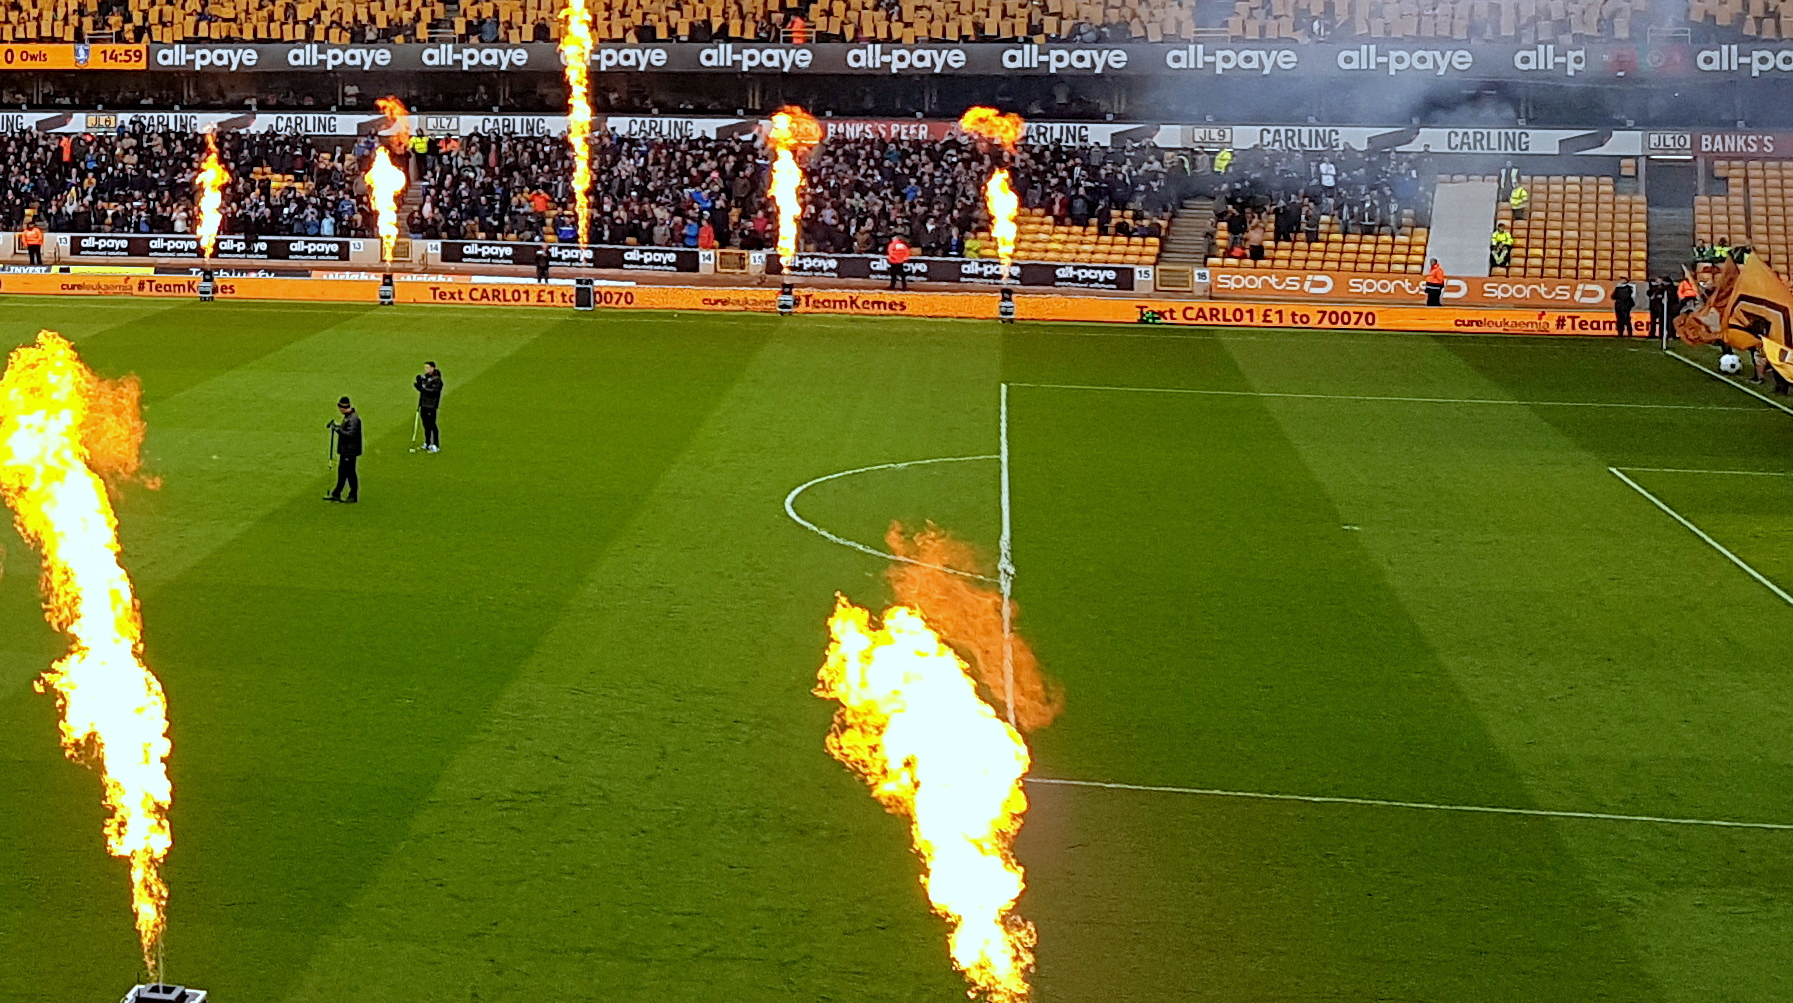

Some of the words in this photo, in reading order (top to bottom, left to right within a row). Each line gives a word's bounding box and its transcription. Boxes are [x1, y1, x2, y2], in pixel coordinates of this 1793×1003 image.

[4, 49, 14, 65] 0
[19, 50, 48, 62] Owls
[100, 49, 143, 64] 14:59
[157, 45, 258, 71] all-paye
[287, 44, 391, 70] all-paye
[421, 44, 528, 70] all-paye
[560, 47, 667, 72] -paye
[699, 44, 812, 72] all-paye
[847, 44, 966, 73] all-paye
[1002, 44, 1128, 74] all-paye
[1166, 44, 1298, 74] all-paye
[1337, 44, 1473, 76] all-paye
[275, 116, 337, 133] CARLING
[432, 118, 452, 130] JL7
[482, 118, 545, 136] CARLING
[628, 119, 694, 137] CARLING
[1026, 124, 1089, 144] ARLING
[1199, 129, 1226, 141] JL9
[1260, 128, 1340, 148] CARLING
[1447, 130, 1530, 152] CARLING
[1653, 134, 1687, 148] JL10
[1701, 134, 1775, 153] BANKS'S
[58, 237, 68, 245] 13
[80, 237, 128, 249] all-paye
[149, 238, 197, 250] all-paye
[289, 241, 339, 254] all-paye
[352, 242, 361, 250] 13
[429, 244, 440, 252] 14
[462, 244, 513, 257] all-paye
[623, 249, 677, 264] all-paye
[701, 253, 712, 262] 14
[1055, 265, 1117, 281] all-paye
[1137, 269, 1150, 279] 15
[1217, 273, 1300, 291] sports
[137, 279, 235, 295] #TeamKes
[429, 286, 464, 301] Text
[468, 287, 531, 303] CARL01
[536, 289, 555, 303] £1
[594, 289, 634, 305] 0070
[1348, 278, 1427, 296] sports
[1483, 282, 1571, 300] sports
[1182, 306, 1255, 323] CARL01
[1262, 307, 1284, 323] £1
[1291, 309, 1311, 325] to
[1316, 310, 1376, 326] 70070
